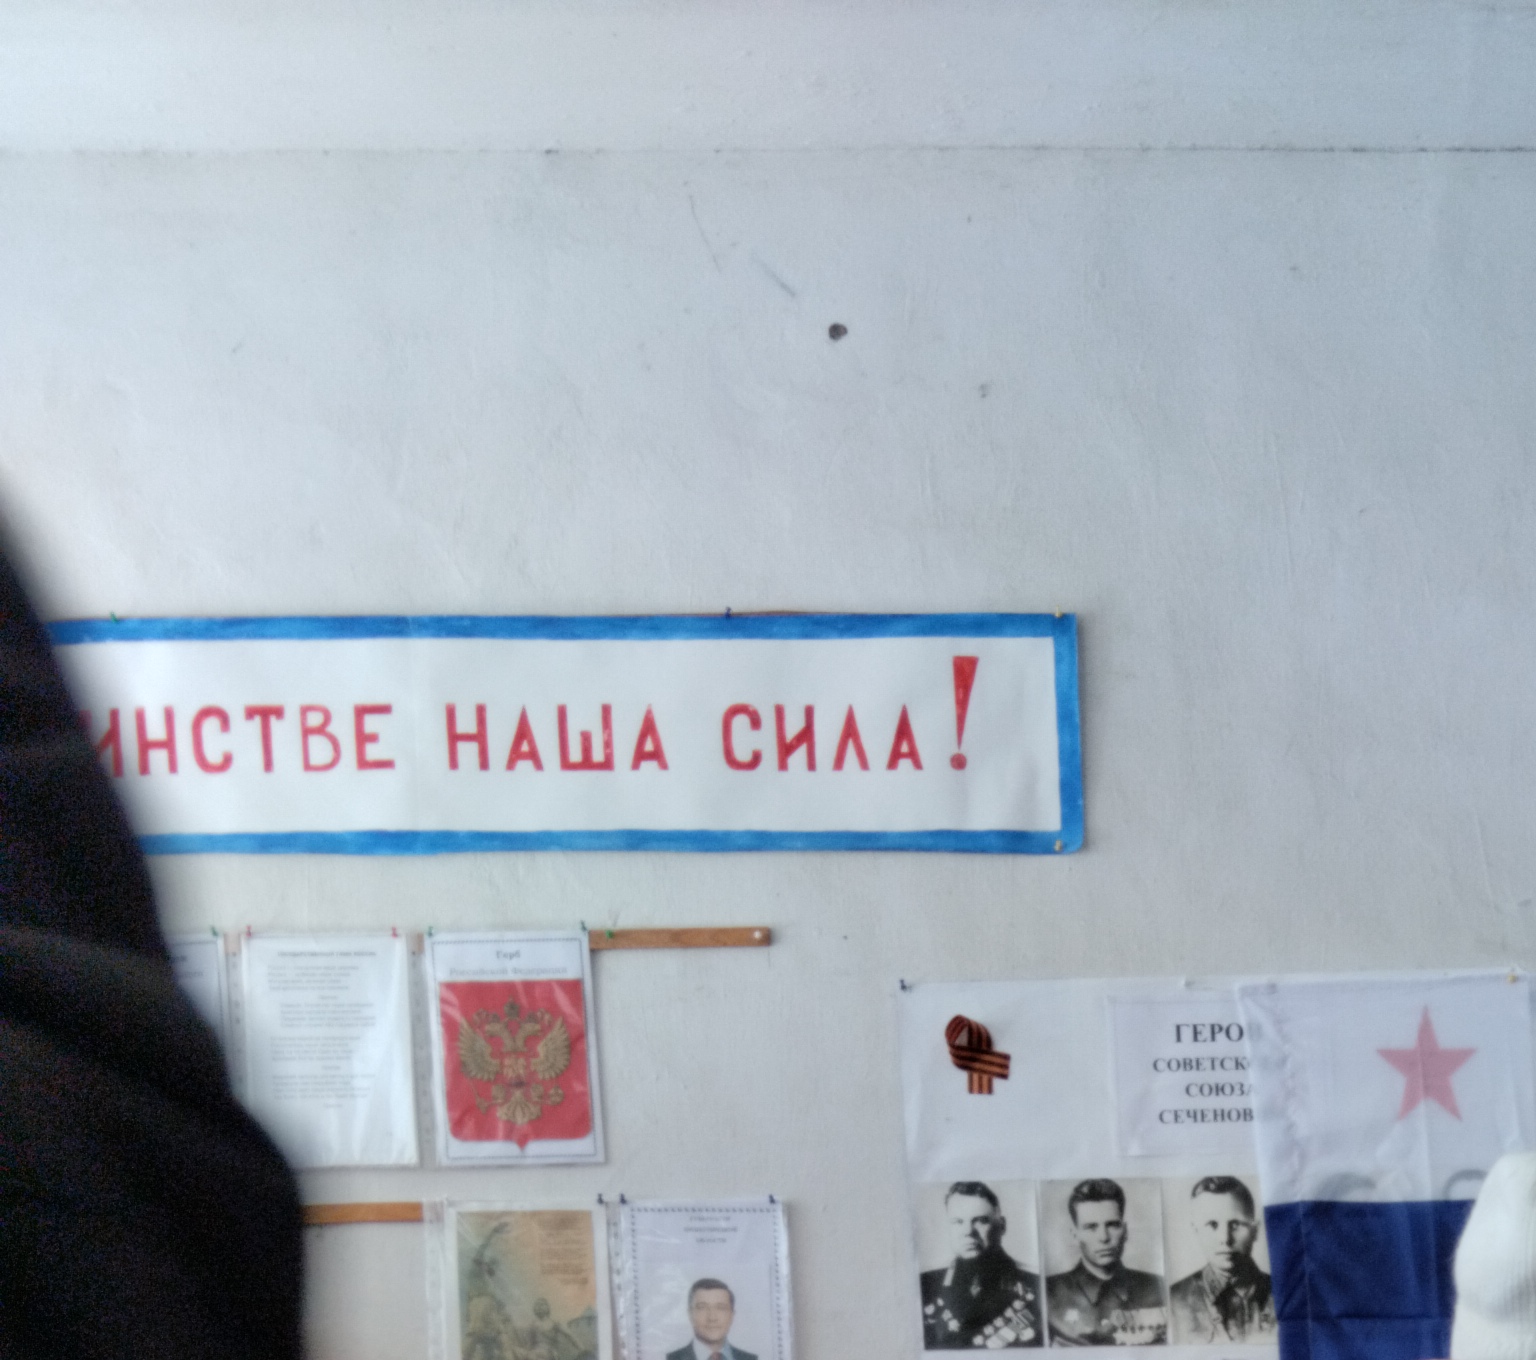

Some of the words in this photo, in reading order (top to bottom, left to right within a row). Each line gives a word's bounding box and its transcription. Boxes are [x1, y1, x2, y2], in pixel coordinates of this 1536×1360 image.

[81, 703, 397, 778] ИНСТВЕ
[445, 703, 670, 772] НАША
[721, 655, 980, 772] СИЛА!
[1174, 1022, 1246, 1043] ГЕРО
[1152, 1056, 1250, 1073] СОВЕТСК
[1158, 1107, 1255, 1124] СЕЧЕНОВ
